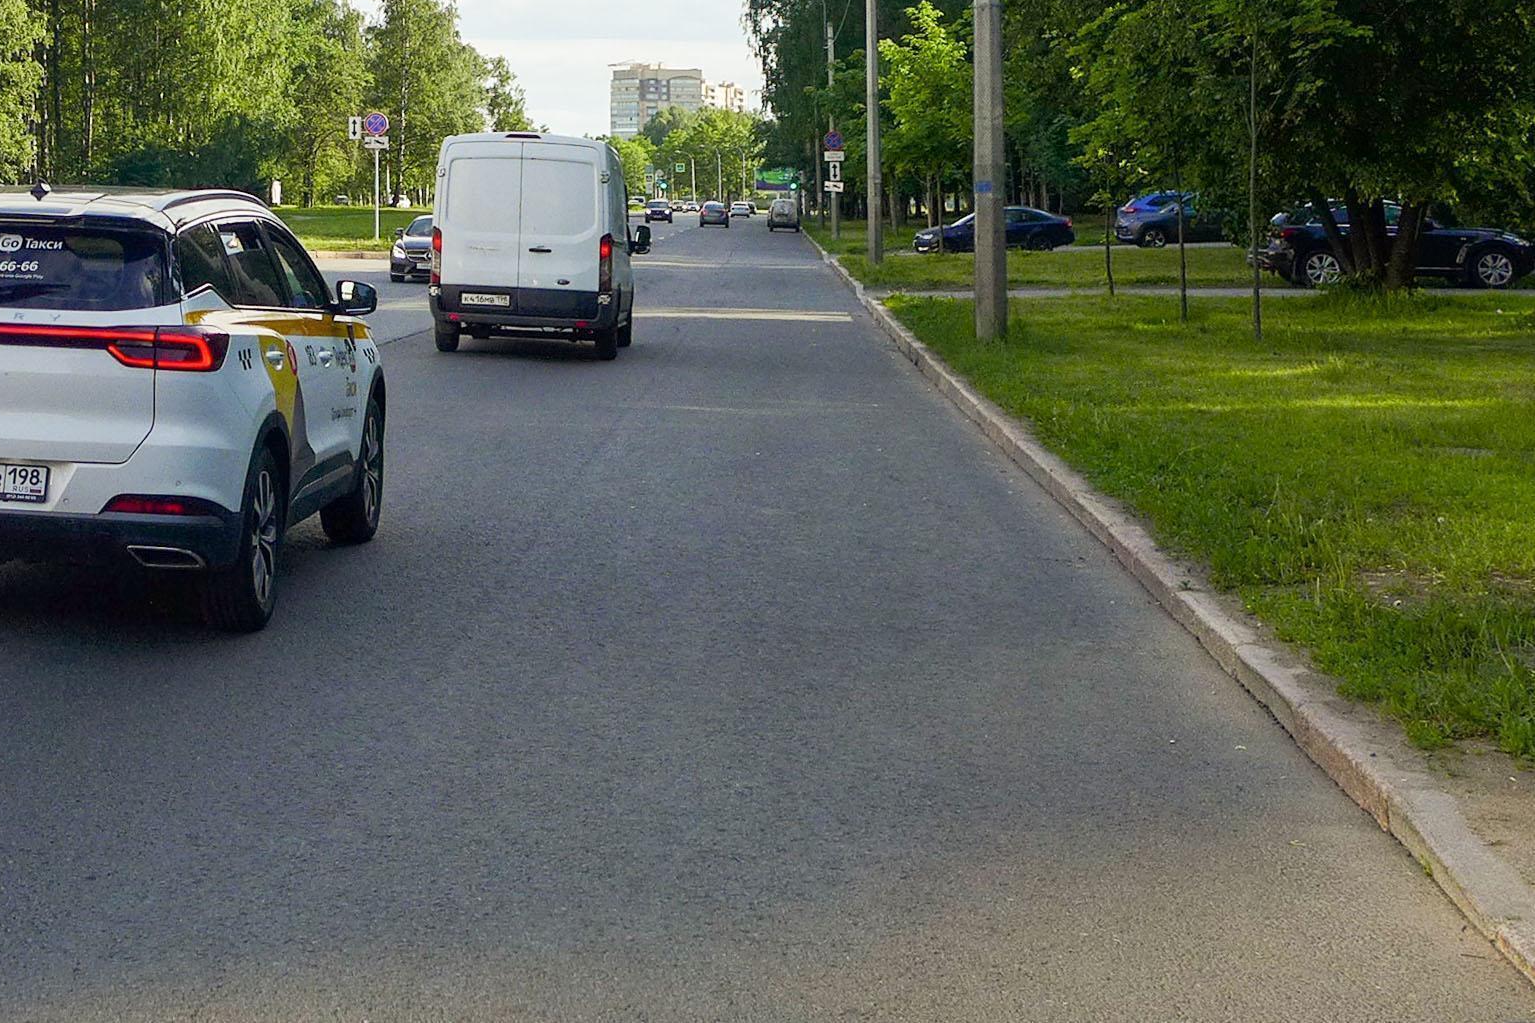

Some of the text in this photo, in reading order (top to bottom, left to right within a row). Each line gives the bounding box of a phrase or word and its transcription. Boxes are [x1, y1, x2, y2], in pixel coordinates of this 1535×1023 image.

[3, 236, 20, 248] Go
[25, 237, 63, 250] Такси
[8, 467, 41, 486] 198
